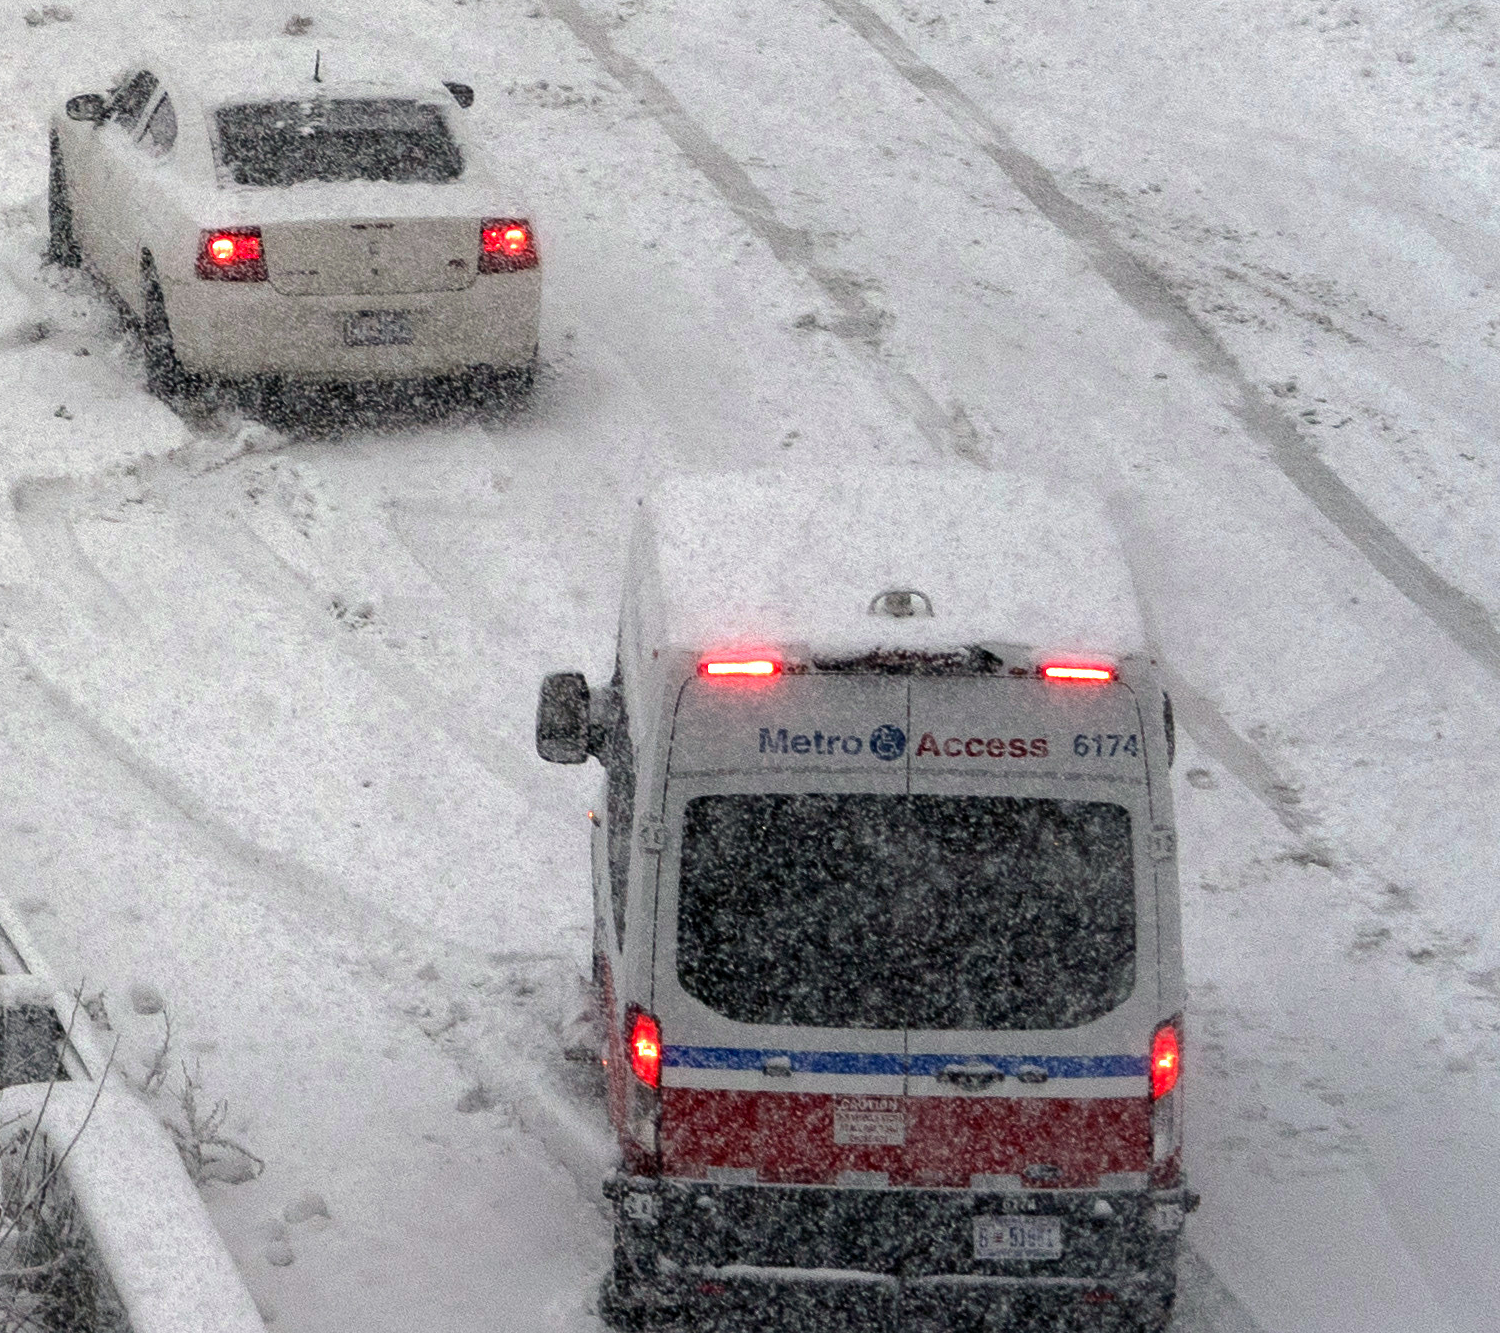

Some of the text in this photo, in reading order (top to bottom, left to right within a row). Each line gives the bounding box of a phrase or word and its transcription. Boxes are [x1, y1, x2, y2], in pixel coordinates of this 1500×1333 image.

[758, 727, 1141, 759] Metro Access 6174
[840, 1097, 898, 1111] CAUTION
